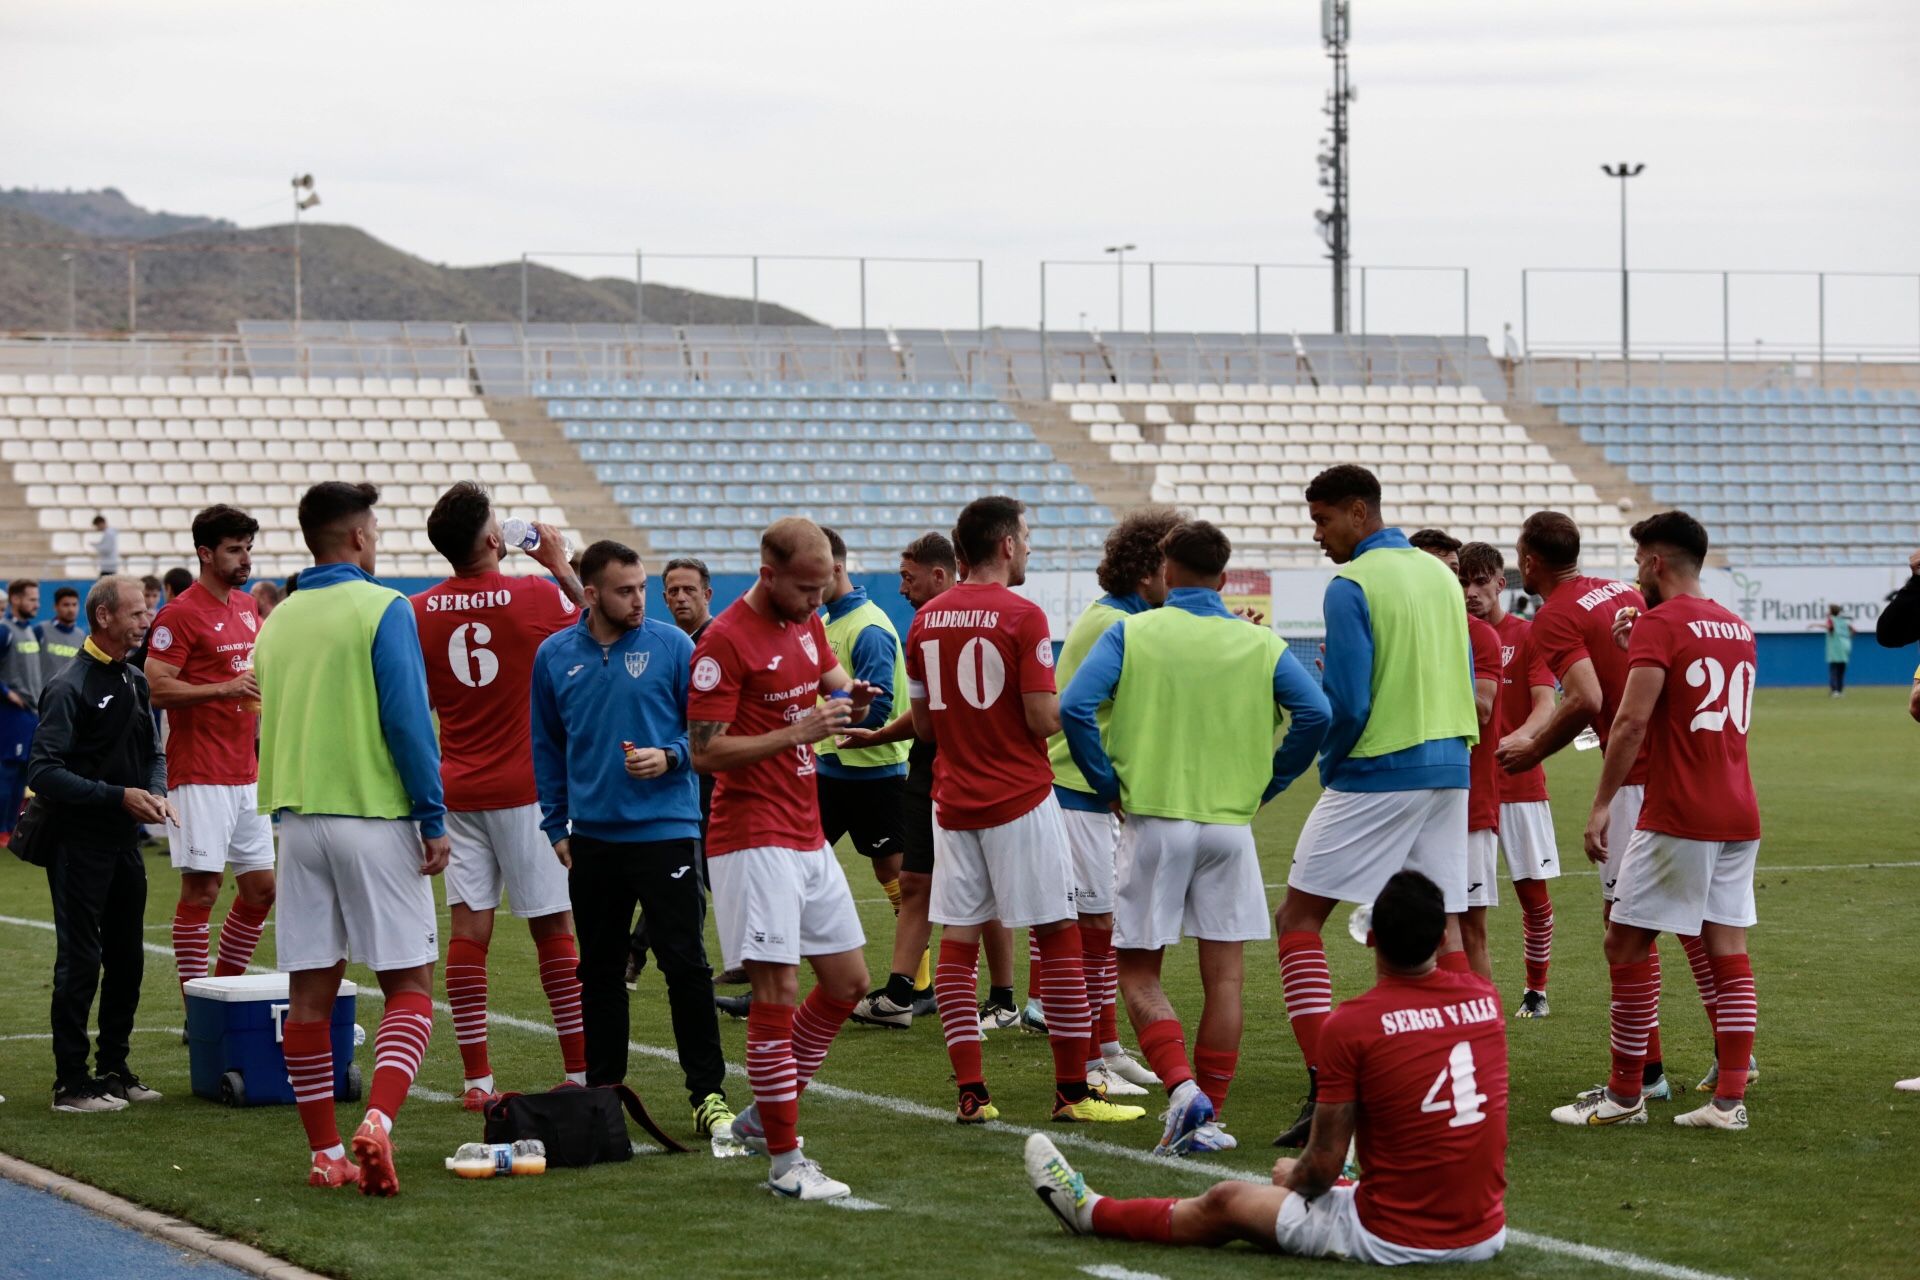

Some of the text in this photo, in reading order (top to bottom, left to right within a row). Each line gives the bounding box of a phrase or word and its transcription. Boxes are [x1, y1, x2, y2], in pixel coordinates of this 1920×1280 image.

[426, 589, 512, 612] SERGIO
[924, 609, 999, 629] VALDEOLIVAS
[448, 622, 499, 688] 6
[1687, 620, 1752, 642] VITOLO
[919, 636, 1006, 711] 10
[1685, 656, 1756, 735] 20
[1380, 996, 1498, 1036] SERGI VALLS
[1420, 1040, 1488, 1128] 4
